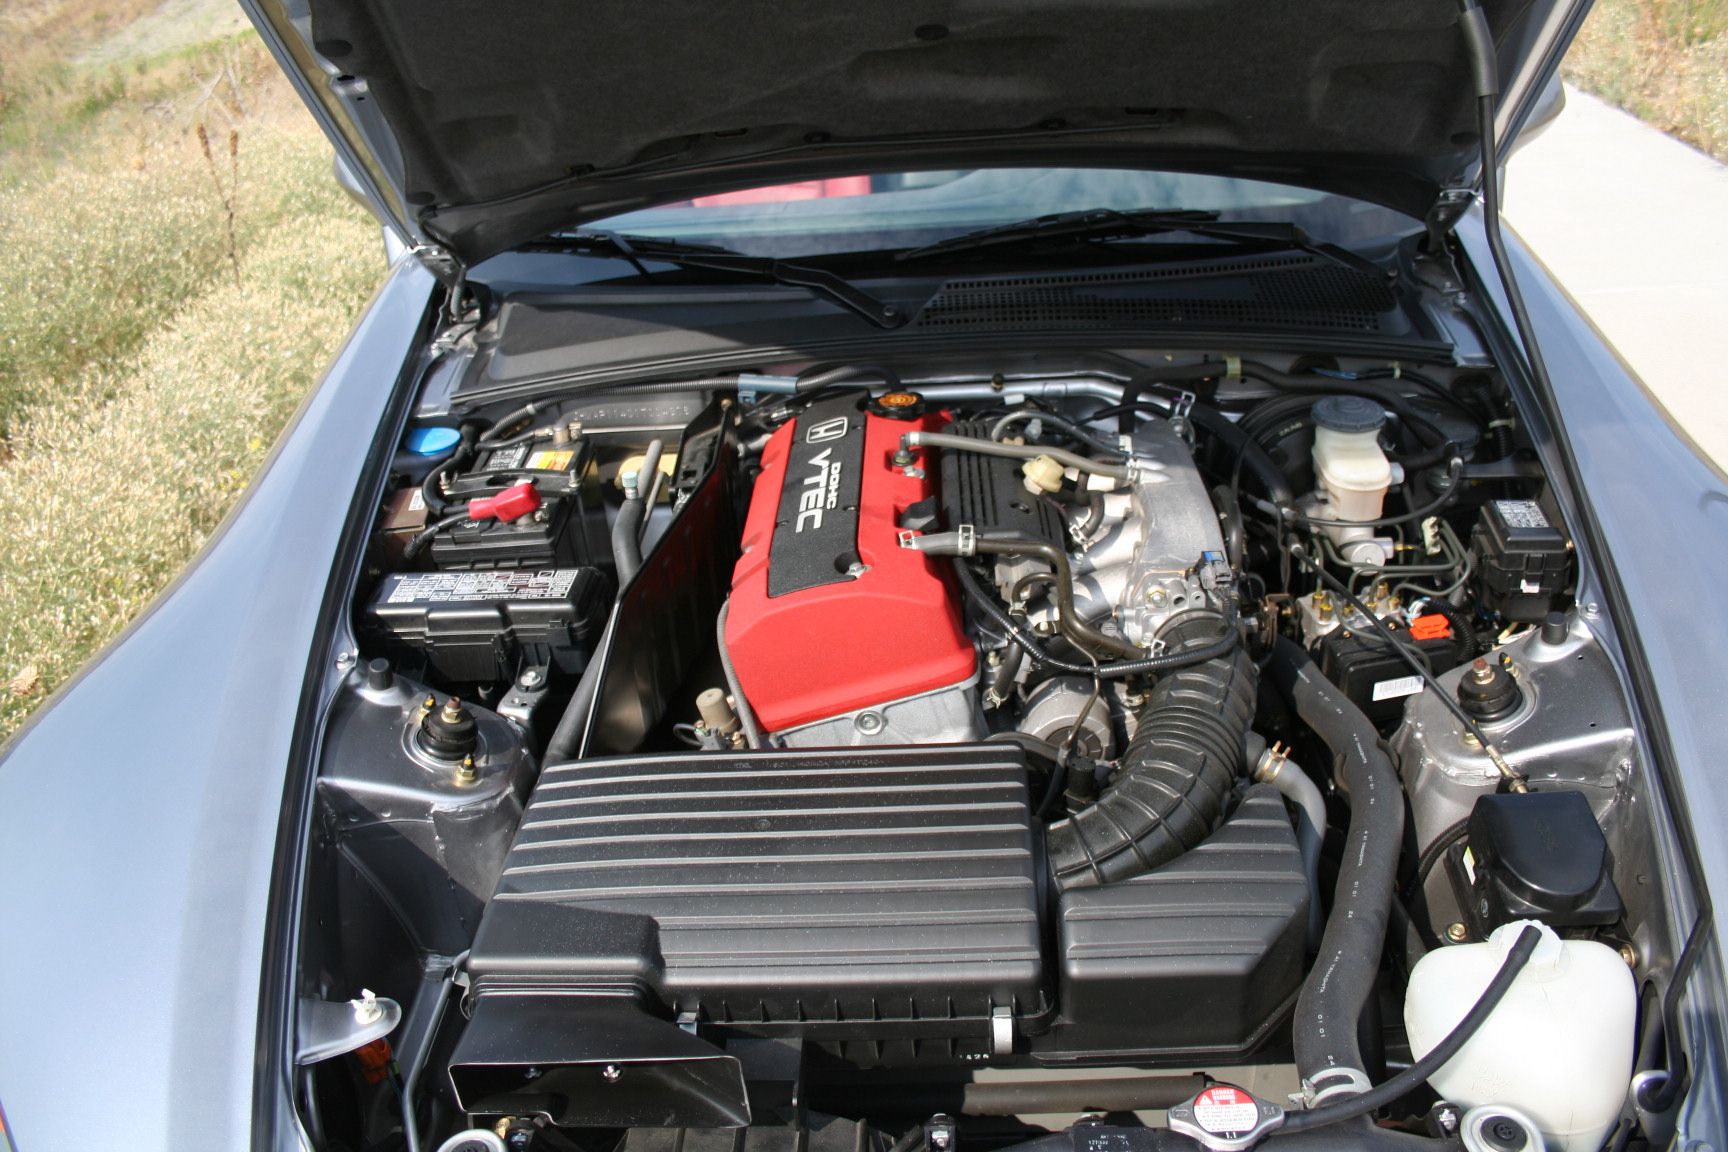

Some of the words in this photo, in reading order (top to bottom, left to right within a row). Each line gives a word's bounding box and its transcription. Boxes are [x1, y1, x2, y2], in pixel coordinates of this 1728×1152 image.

[796, 447, 832, 533] VTEC
[826, 461, 842, 510] DOHC
[1317, 1014, 1323, 1023] 01
[1319, 1027, 1326, 1038] 01
[1225, 1131, 1237, 1139] 1.1
